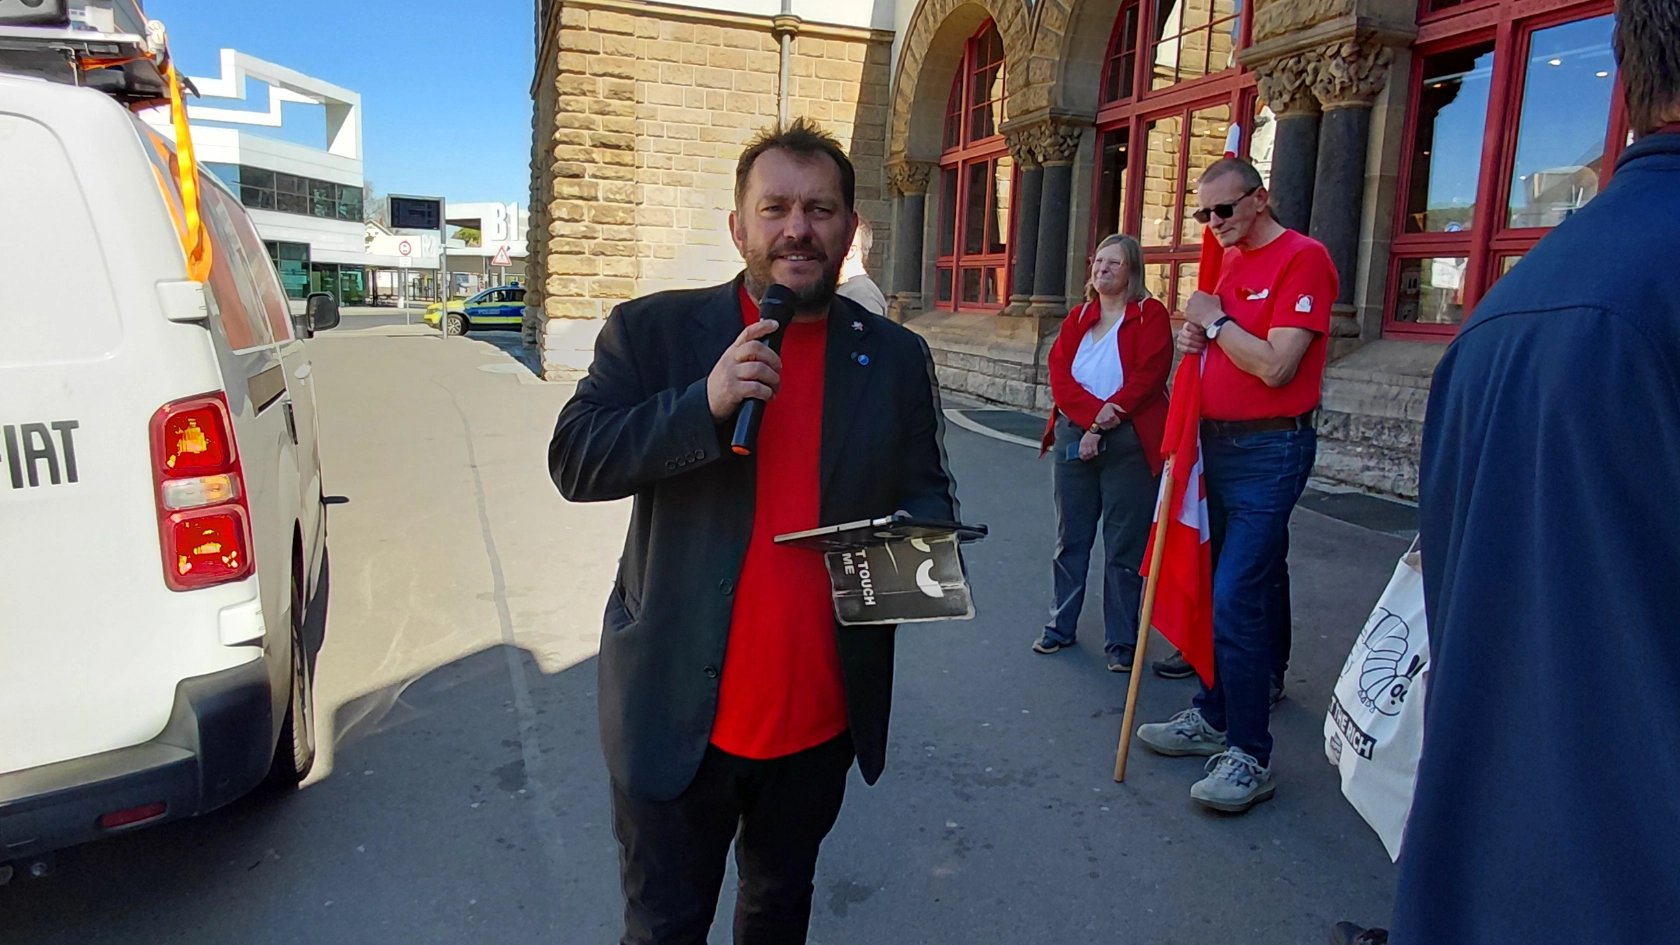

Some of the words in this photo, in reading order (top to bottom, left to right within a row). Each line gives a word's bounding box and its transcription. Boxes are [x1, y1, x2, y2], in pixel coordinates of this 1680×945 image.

[490, 201, 519, 241] B1
[0, 420, 79, 489] IAT
[841, 552, 855, 575] ME
[857, 560, 876, 606] TOUCH
[1333, 702, 1349, 733] THE
[1345, 721, 1373, 758] RICH
